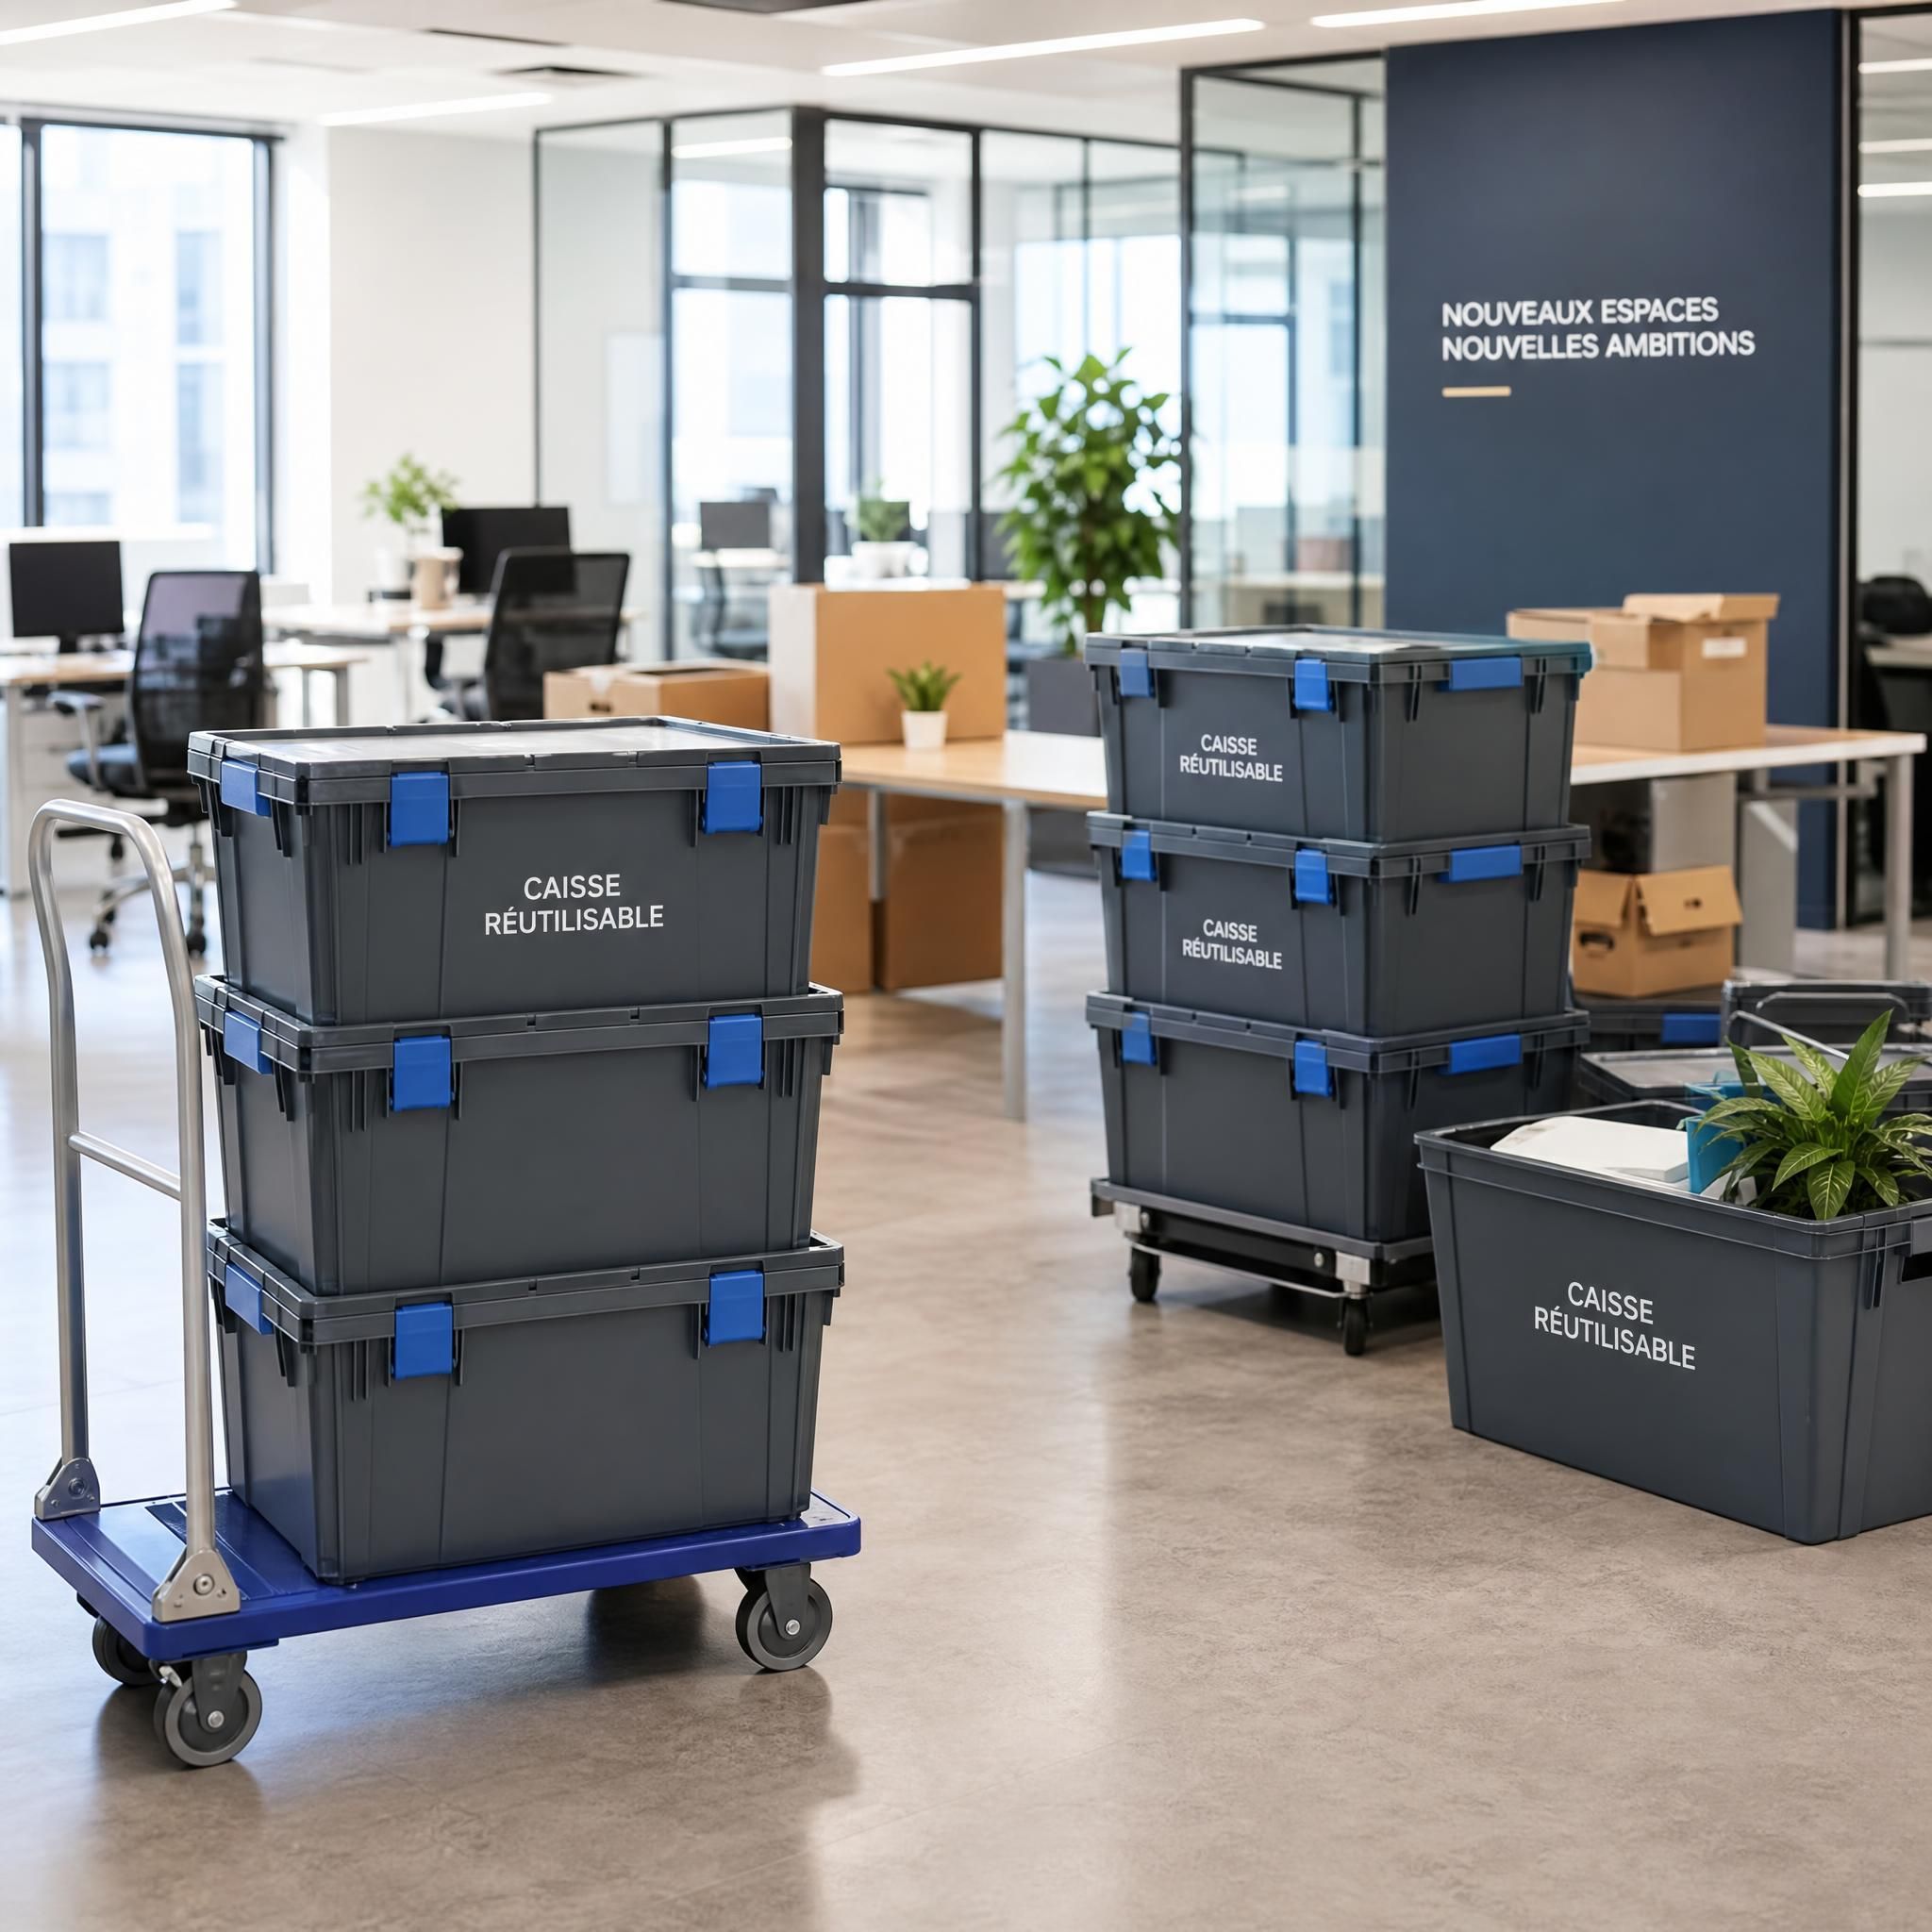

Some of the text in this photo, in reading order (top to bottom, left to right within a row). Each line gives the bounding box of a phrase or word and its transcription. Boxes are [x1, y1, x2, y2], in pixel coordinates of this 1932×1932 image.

[1441, 296, 1720, 327] NOUVEAUX ESPACES
[1441, 330, 1757, 361] NOUVELLES AMBITIONS
[1200, 733, 1257, 756] CAISSE
[1179, 753, 1283, 782] RÉUTILISABLE
[524, 874, 621, 900] CAISSE
[484, 904, 664, 936] RÉUTILISABLE
[1203, 918, 1257, 942] CAISSE
[1182, 937, 1283, 970] RÉUTILISABLE
[1567, 1281, 1654, 1324] CAISSE
[1534, 1306, 1696, 1370] RÉUTILISABLE
